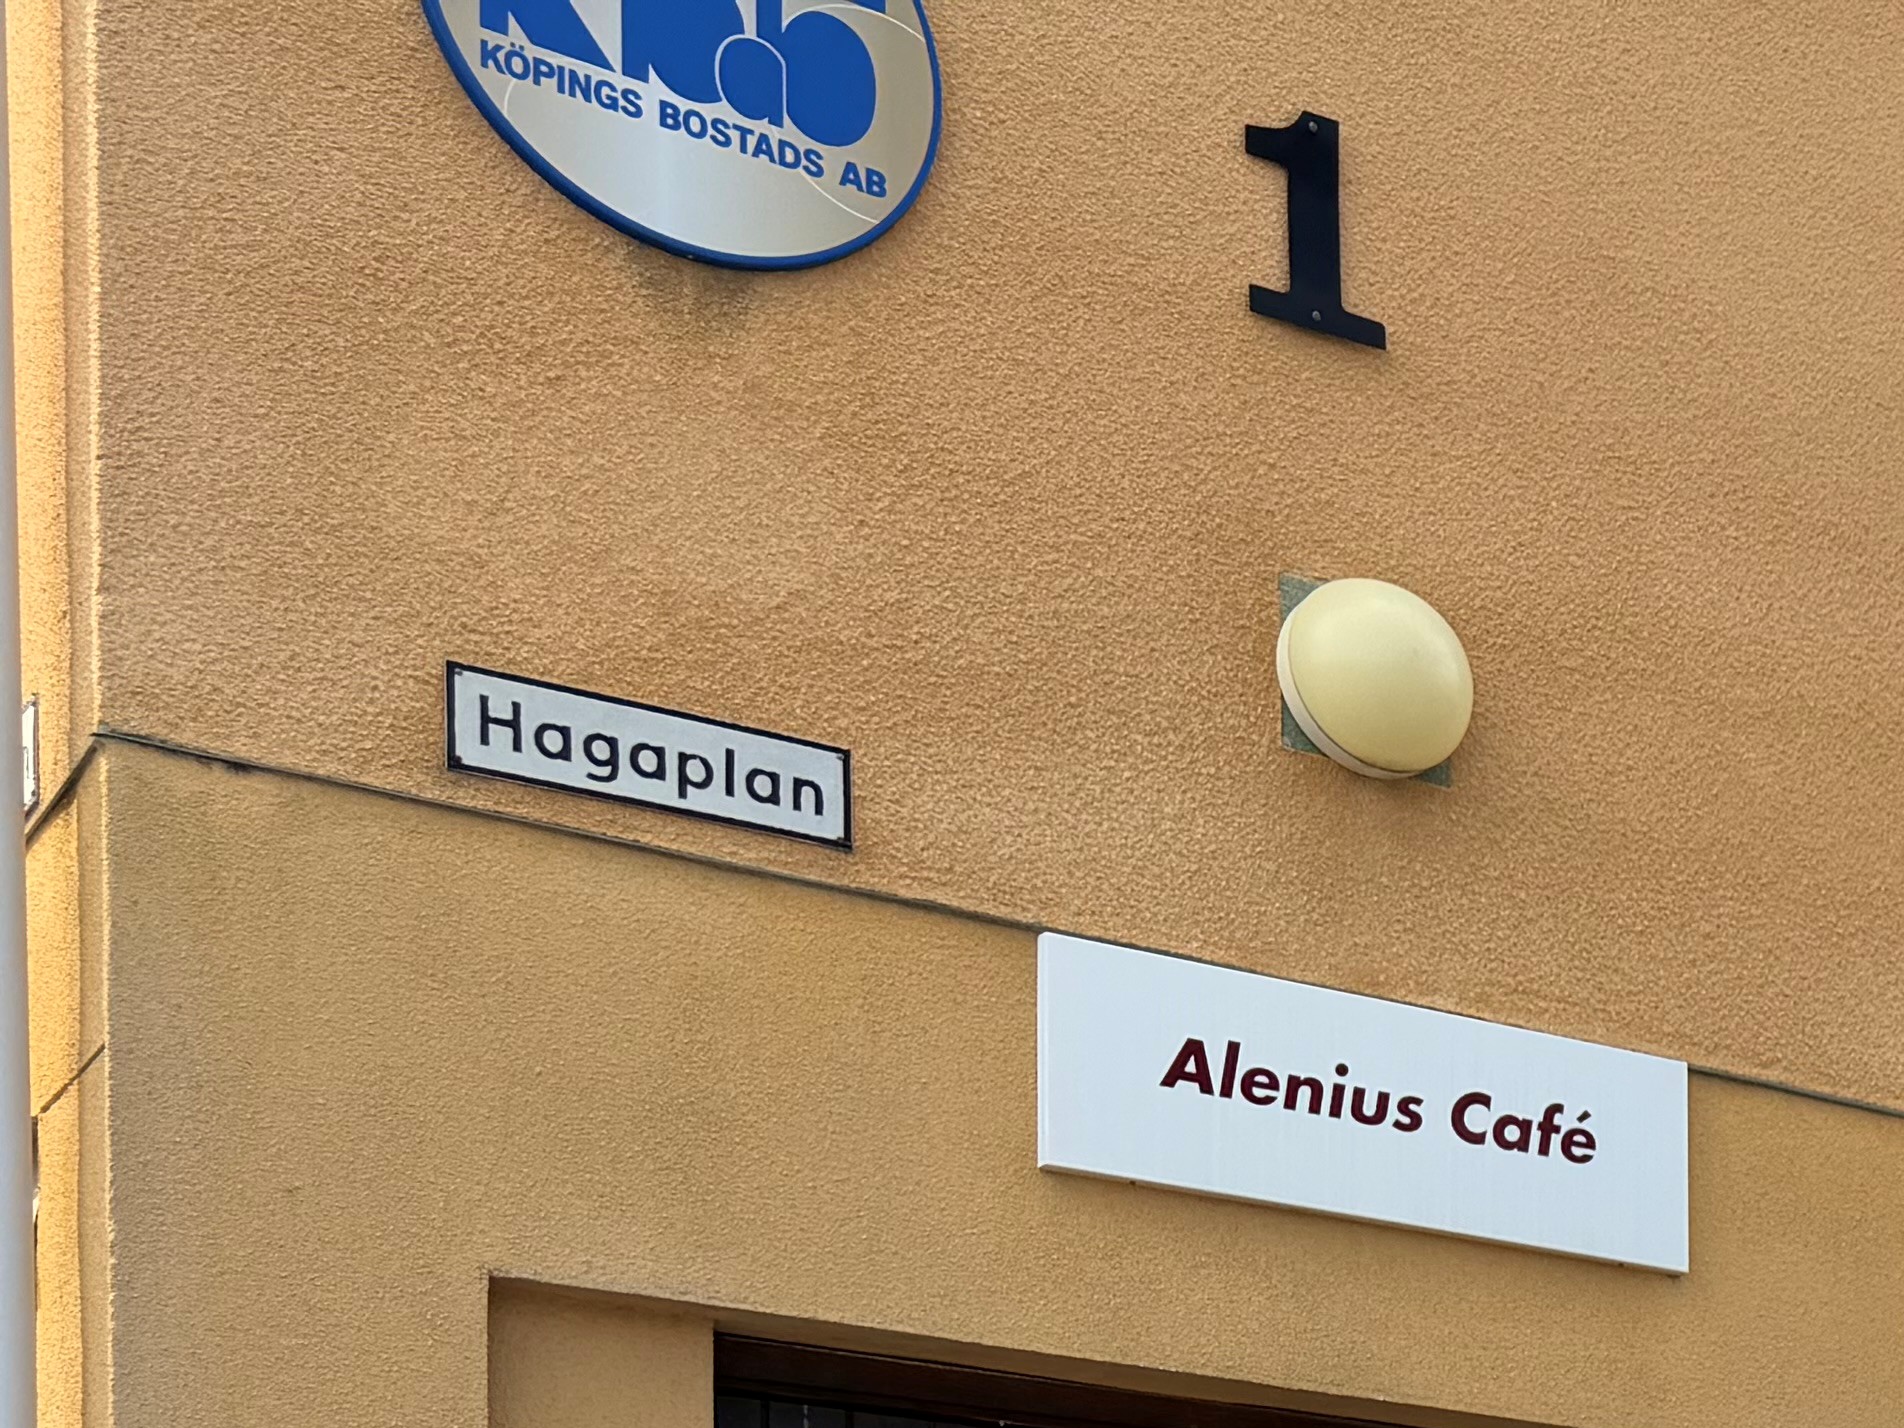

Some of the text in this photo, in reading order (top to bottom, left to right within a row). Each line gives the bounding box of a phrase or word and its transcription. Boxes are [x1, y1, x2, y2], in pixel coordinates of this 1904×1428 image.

[479, 39, 888, 199] KÖPINGS BOSTADS AB
[1244, 110, 1388, 351] 1
[478, 693, 825, 816] Hagaplan
[1159, 1037, 1598, 1166] Alenius Café
